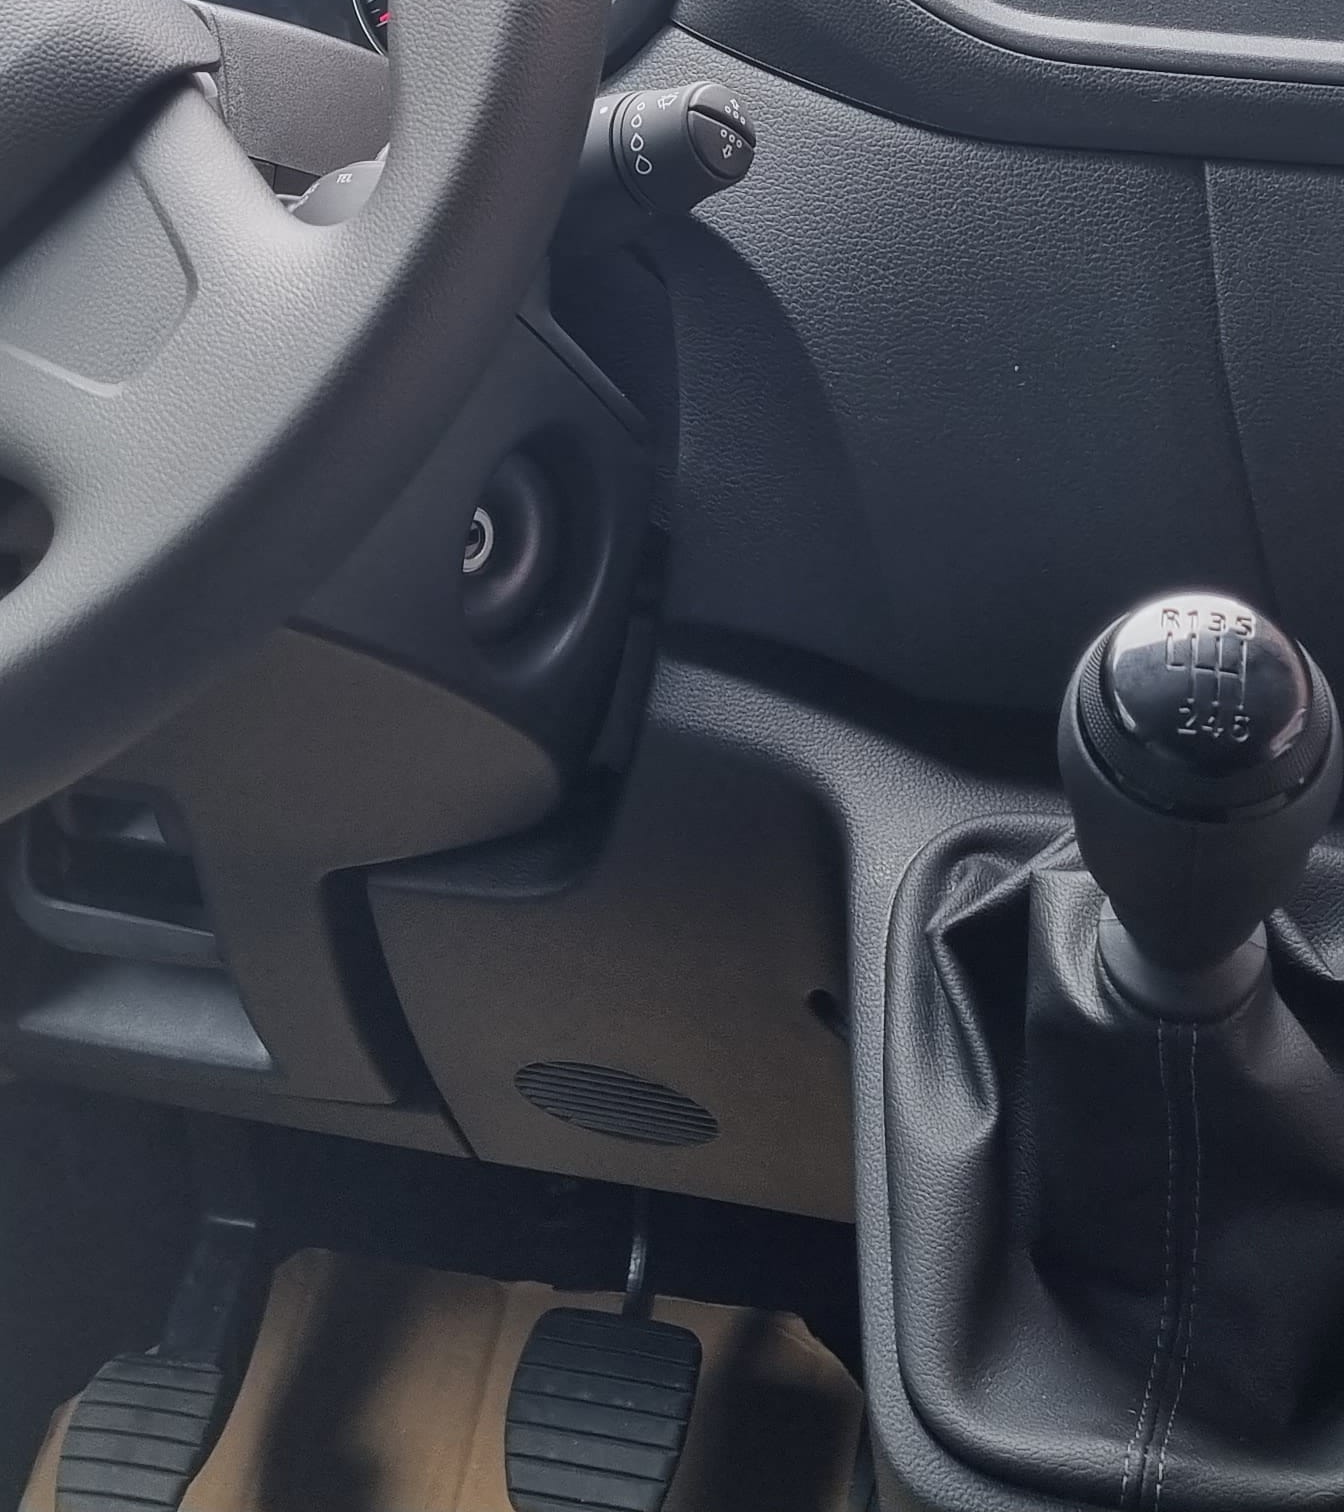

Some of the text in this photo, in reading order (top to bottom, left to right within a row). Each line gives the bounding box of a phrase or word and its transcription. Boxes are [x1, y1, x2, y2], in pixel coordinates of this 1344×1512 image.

[1161, 607, 1255, 638] R 1 3 5
[1177, 707, 1197, 735] 2
